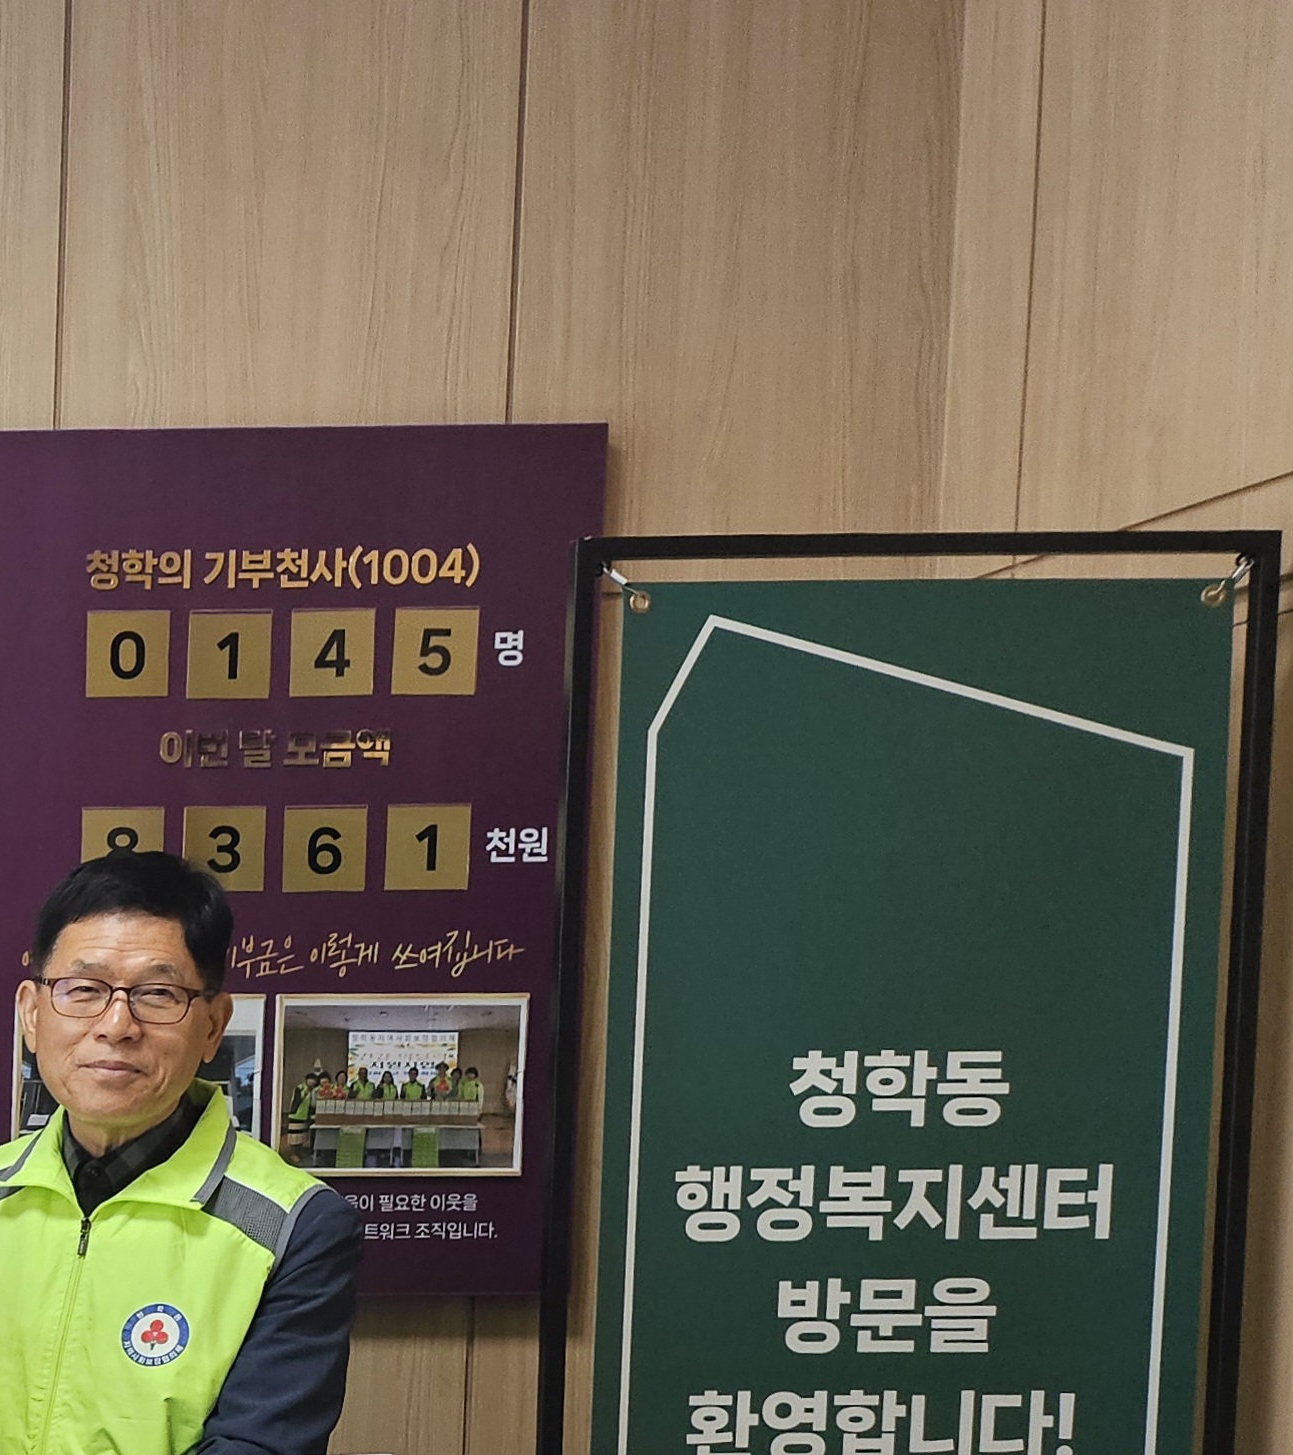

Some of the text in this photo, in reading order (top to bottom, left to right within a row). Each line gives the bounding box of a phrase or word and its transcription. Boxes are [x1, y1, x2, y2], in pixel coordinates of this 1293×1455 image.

[85, 543, 480, 591] 청학의 기부천사(1004)
[109, 628, 525, 680] 0 1 4 5 명
[158, 728, 392, 768] 이번 달 모금액
[207, 825, 241, 873] 3
[307, 826, 342, 874] 6
[415, 823, 438, 871] 1
[485, 826, 549, 864] 천원
[310, 932, 380, 978] 이렇게
[789, 1049, 1010, 1128] 청학동
[378, 1193, 478, 1212] 필요한 이웃을
[674, 1163, 1114, 1242] 행정복지센터
[413, 1221, 498, 1240] 조직입니다.
[777, 1277, 997, 1354] 방문을
